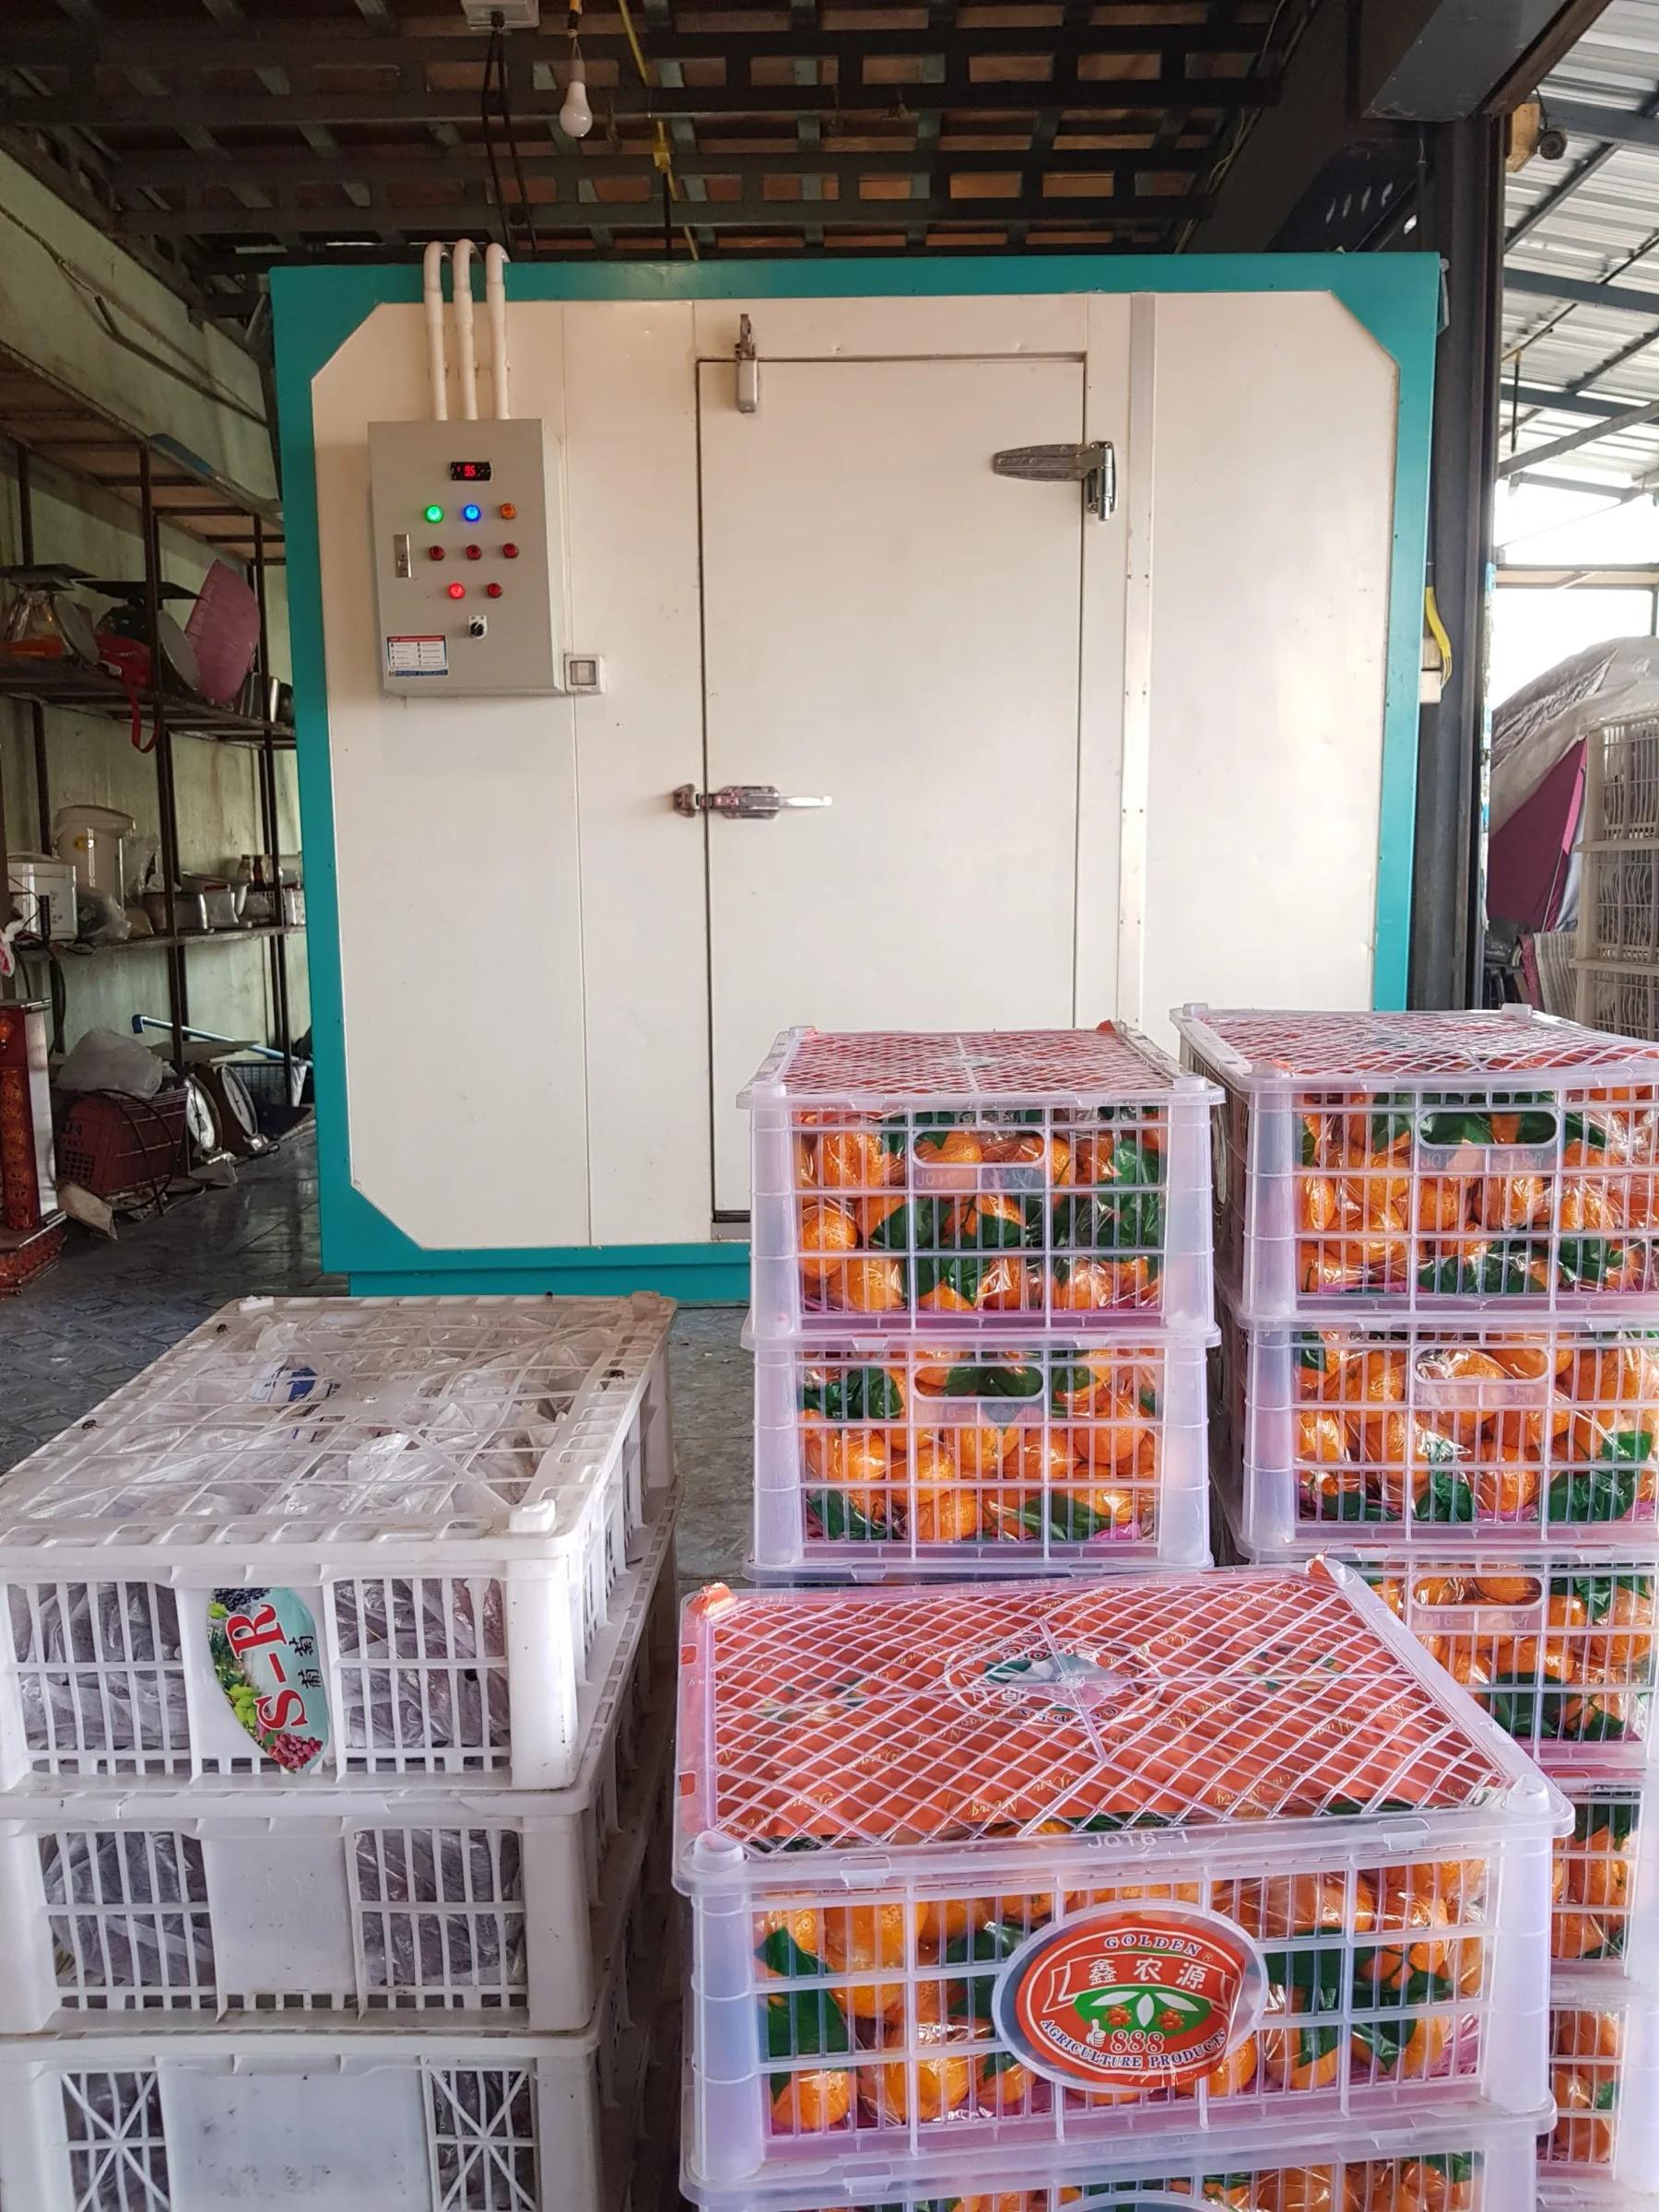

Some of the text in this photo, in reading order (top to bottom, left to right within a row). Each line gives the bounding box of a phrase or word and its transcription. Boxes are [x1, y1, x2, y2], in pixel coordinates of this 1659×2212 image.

[226, 1604, 309, 1730] S-R
[1104, 1935, 1202, 1957] GOLDEN
[1088, 1958, 1207, 1991] 鑫农源
[1040, 2018, 1227, 2069] AGRICULTURE PRODUCTS
[1111, 2030, 1165, 2053] 888
